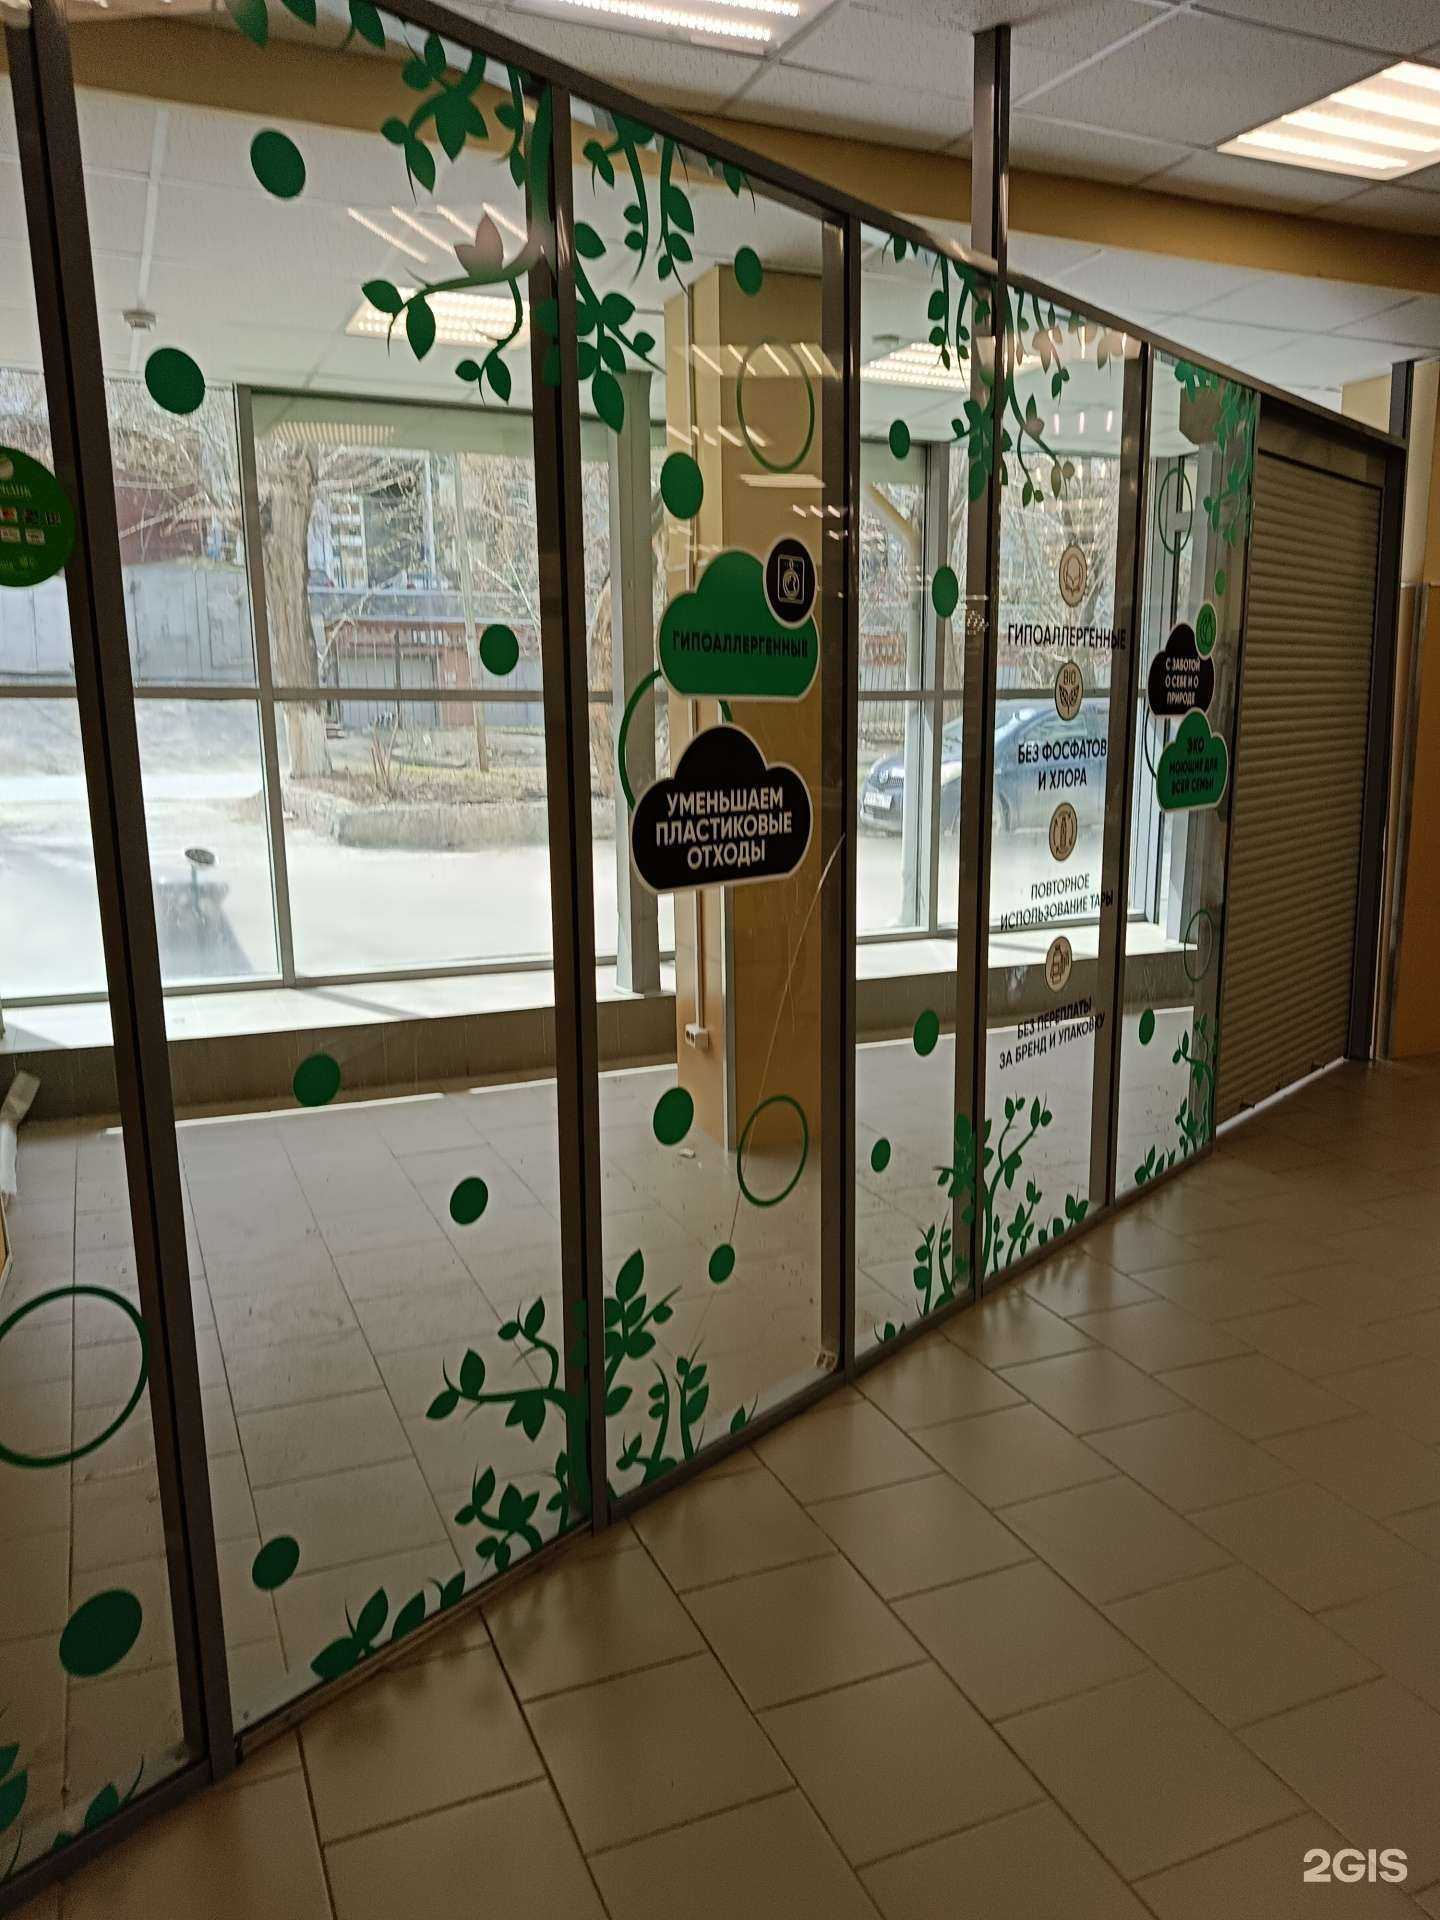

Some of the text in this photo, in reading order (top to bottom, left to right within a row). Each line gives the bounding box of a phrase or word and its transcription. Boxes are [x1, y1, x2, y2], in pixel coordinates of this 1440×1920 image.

[672, 629, 808, 658] ГИПОАЛЛЕРГЕННЫЕ
[1008, 624, 1126, 650] ГИПОАЛЛЕРГЕННЫЕ
[1063, 669, 1077, 685] BIO
[1165, 657, 1201, 672] С ЗАБОТОЙ
[1165, 674, 1171, 688] О
[1171, 674, 1187, 688] СЕБЕ
[1193, 674, 1199, 688] О
[1167, 691, 1195, 706] ПРИРОДЕ
[1018, 739, 1107, 764] БЕЗ ФОСФАТОВ
[1187, 736, 1205, 755] ЭКО
[1038, 767, 1088, 790] И ХЛОРА
[666, 786, 783, 817] УМЕНЬШАЕМ
[656, 811, 793, 847] ПЛАСТИКОВЫЕ
[687, 840, 766, 870] ОТХОДЫ
[1031, 873, 1090, 900] ПОВТОРНОЕ
[1000, 889, 1113, 931] ИСПОЛЬЗОВАНИЕ ТАРЫ
[1018, 996, 1092, 1039] БЕЗ ПЕРЕПЛАТЫ
[1000, 1012, 1106, 1070] ЗА БРЕНД И УПАКОВКУ
